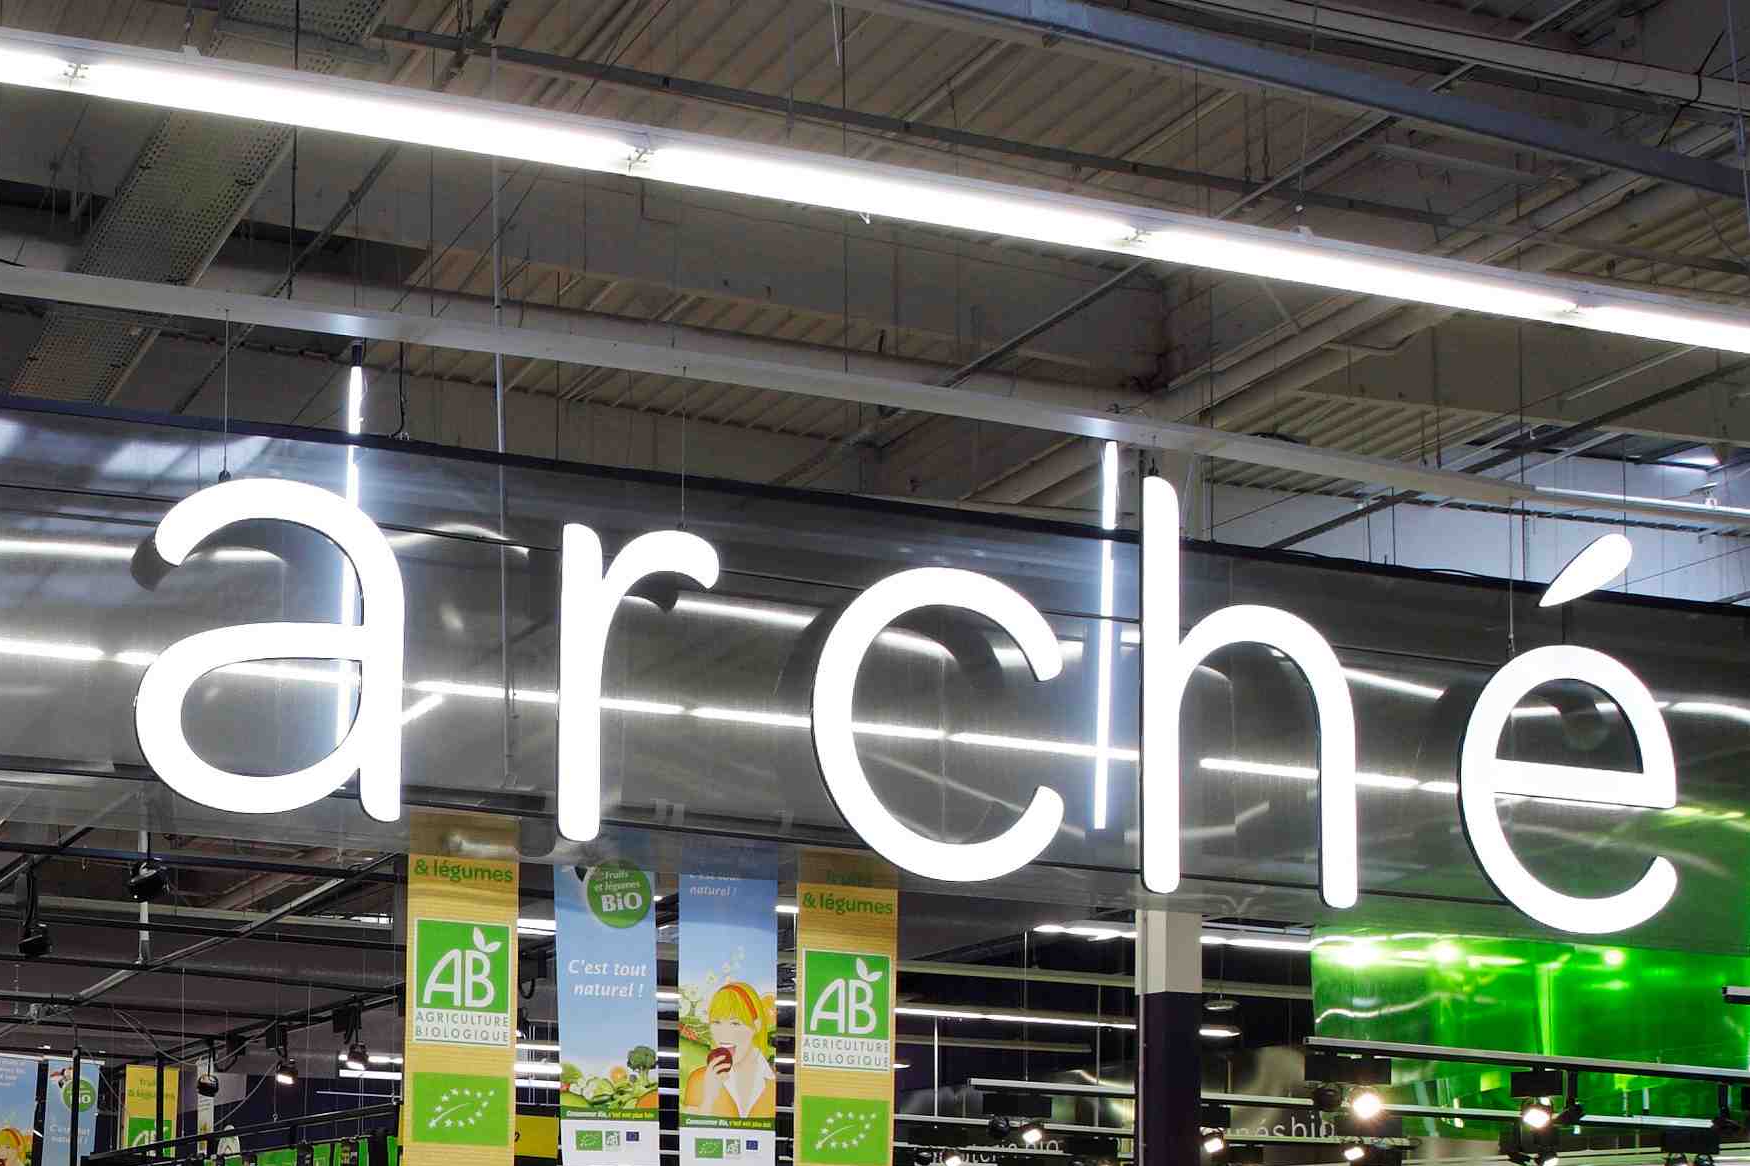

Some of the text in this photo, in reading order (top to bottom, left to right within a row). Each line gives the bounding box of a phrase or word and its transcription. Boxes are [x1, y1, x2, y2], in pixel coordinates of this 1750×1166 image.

[434, 860, 514, 883] légumes
[820, 893, 893, 916] légumes
[568, 959, 647, 977] C'est tout
[423, 948, 495, 1008] AB
[573, 983, 634, 998] naturel
[810, 978, 877, 1035] AB
[415, 1011, 510, 1028] AGRICULTURE
[415, 1027, 509, 1043] BIOLOGIQUE
[803, 1037, 890, 1054] AGRICULTURE
[803, 1051, 890, 1069] BIOLOGIQUE
